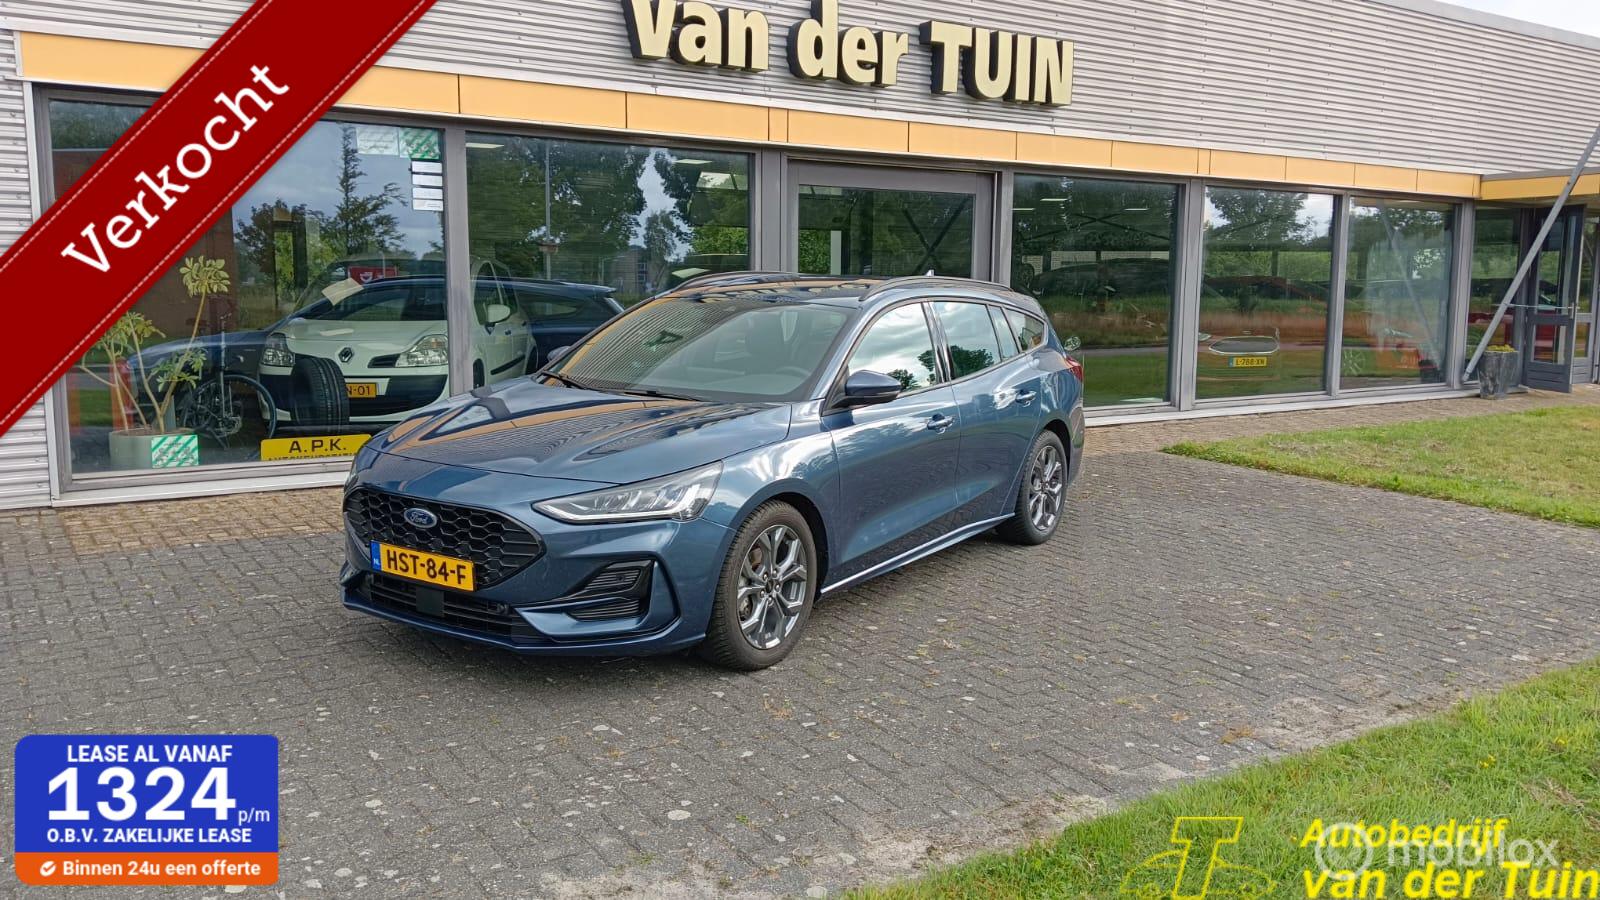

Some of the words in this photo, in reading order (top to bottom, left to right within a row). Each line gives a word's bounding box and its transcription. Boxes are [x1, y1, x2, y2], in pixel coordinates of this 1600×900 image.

[788, 0, 909, 86] der
[921, 20, 1074, 106] TUIN
[288, 438, 346, 454] A.P.K.
[386, 549, 466, 585] HST-84-F
